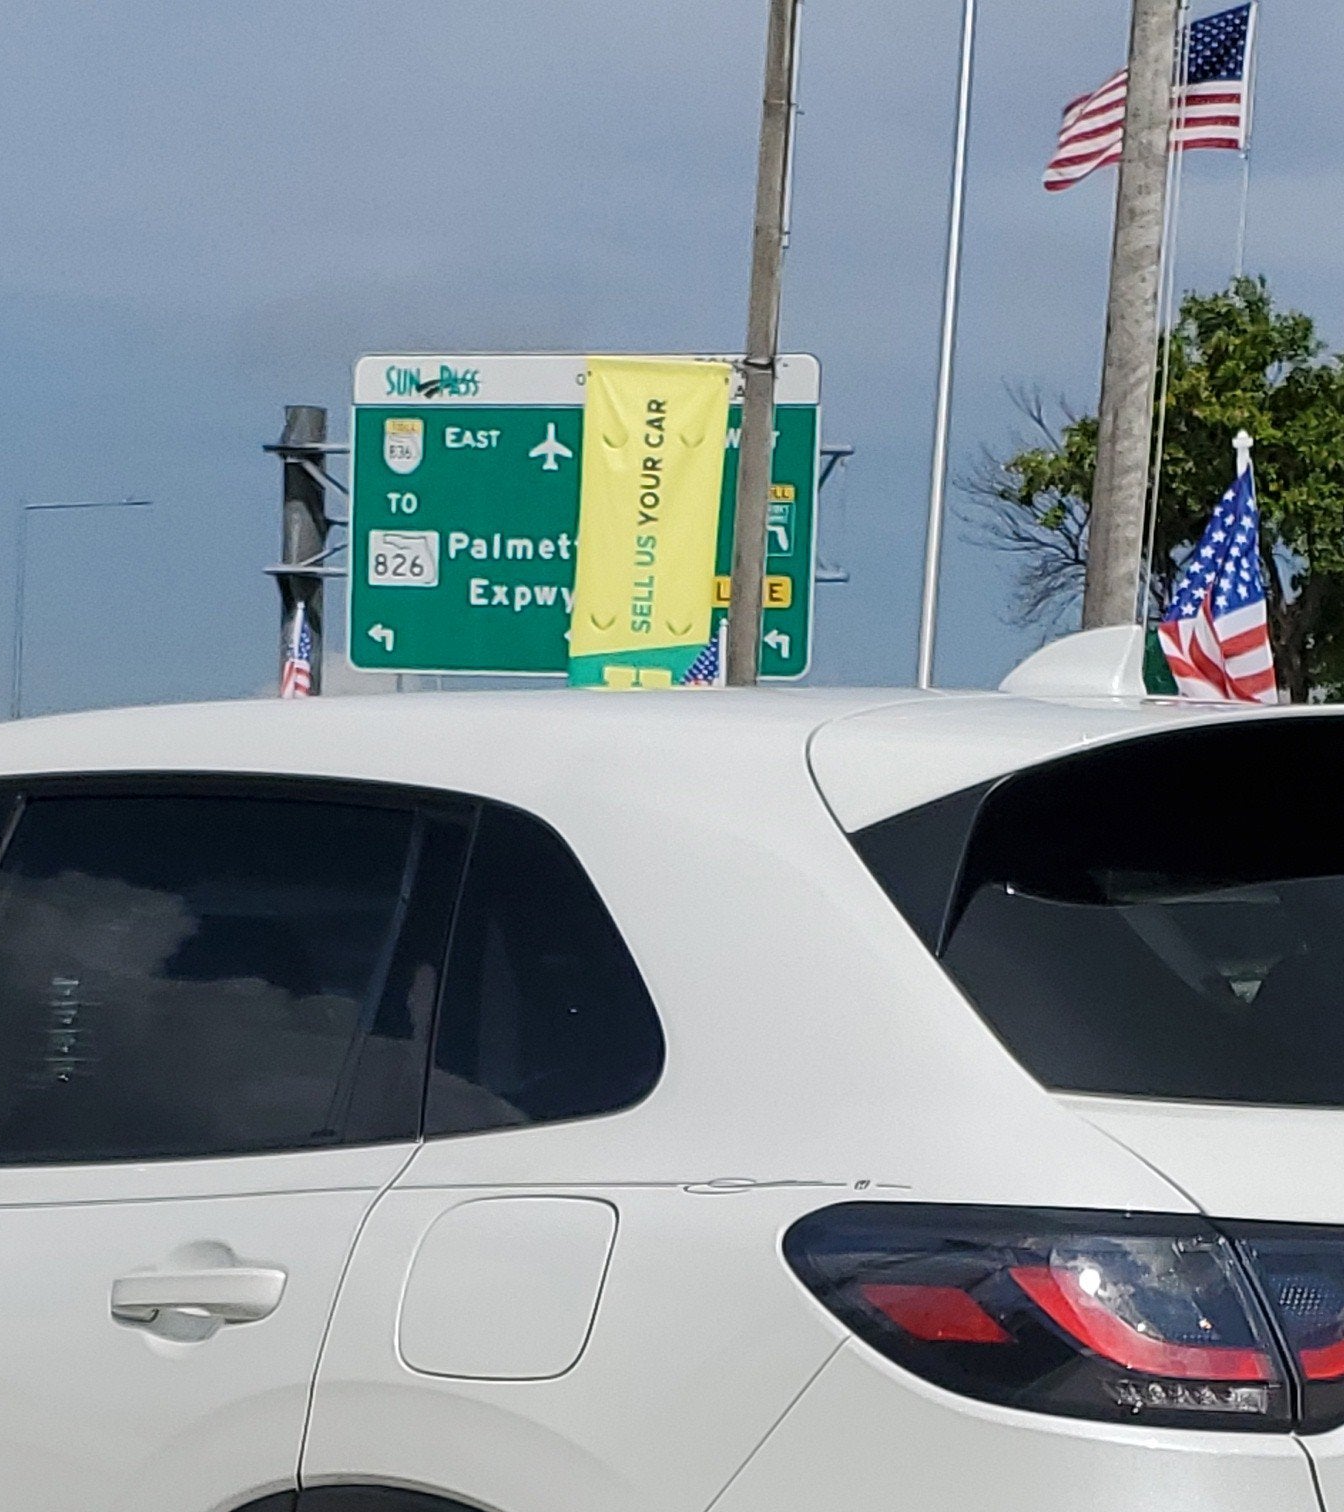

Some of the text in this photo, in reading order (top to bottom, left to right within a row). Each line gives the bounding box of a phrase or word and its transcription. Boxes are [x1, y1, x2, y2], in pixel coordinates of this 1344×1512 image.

[445, 427, 500, 448] EAST
[386, 492, 418, 514] TO
[631, 398, 668, 634] SELL US YOUR CAR
[448, 532, 578, 559] Palmet
[374, 553, 424, 577] 826
